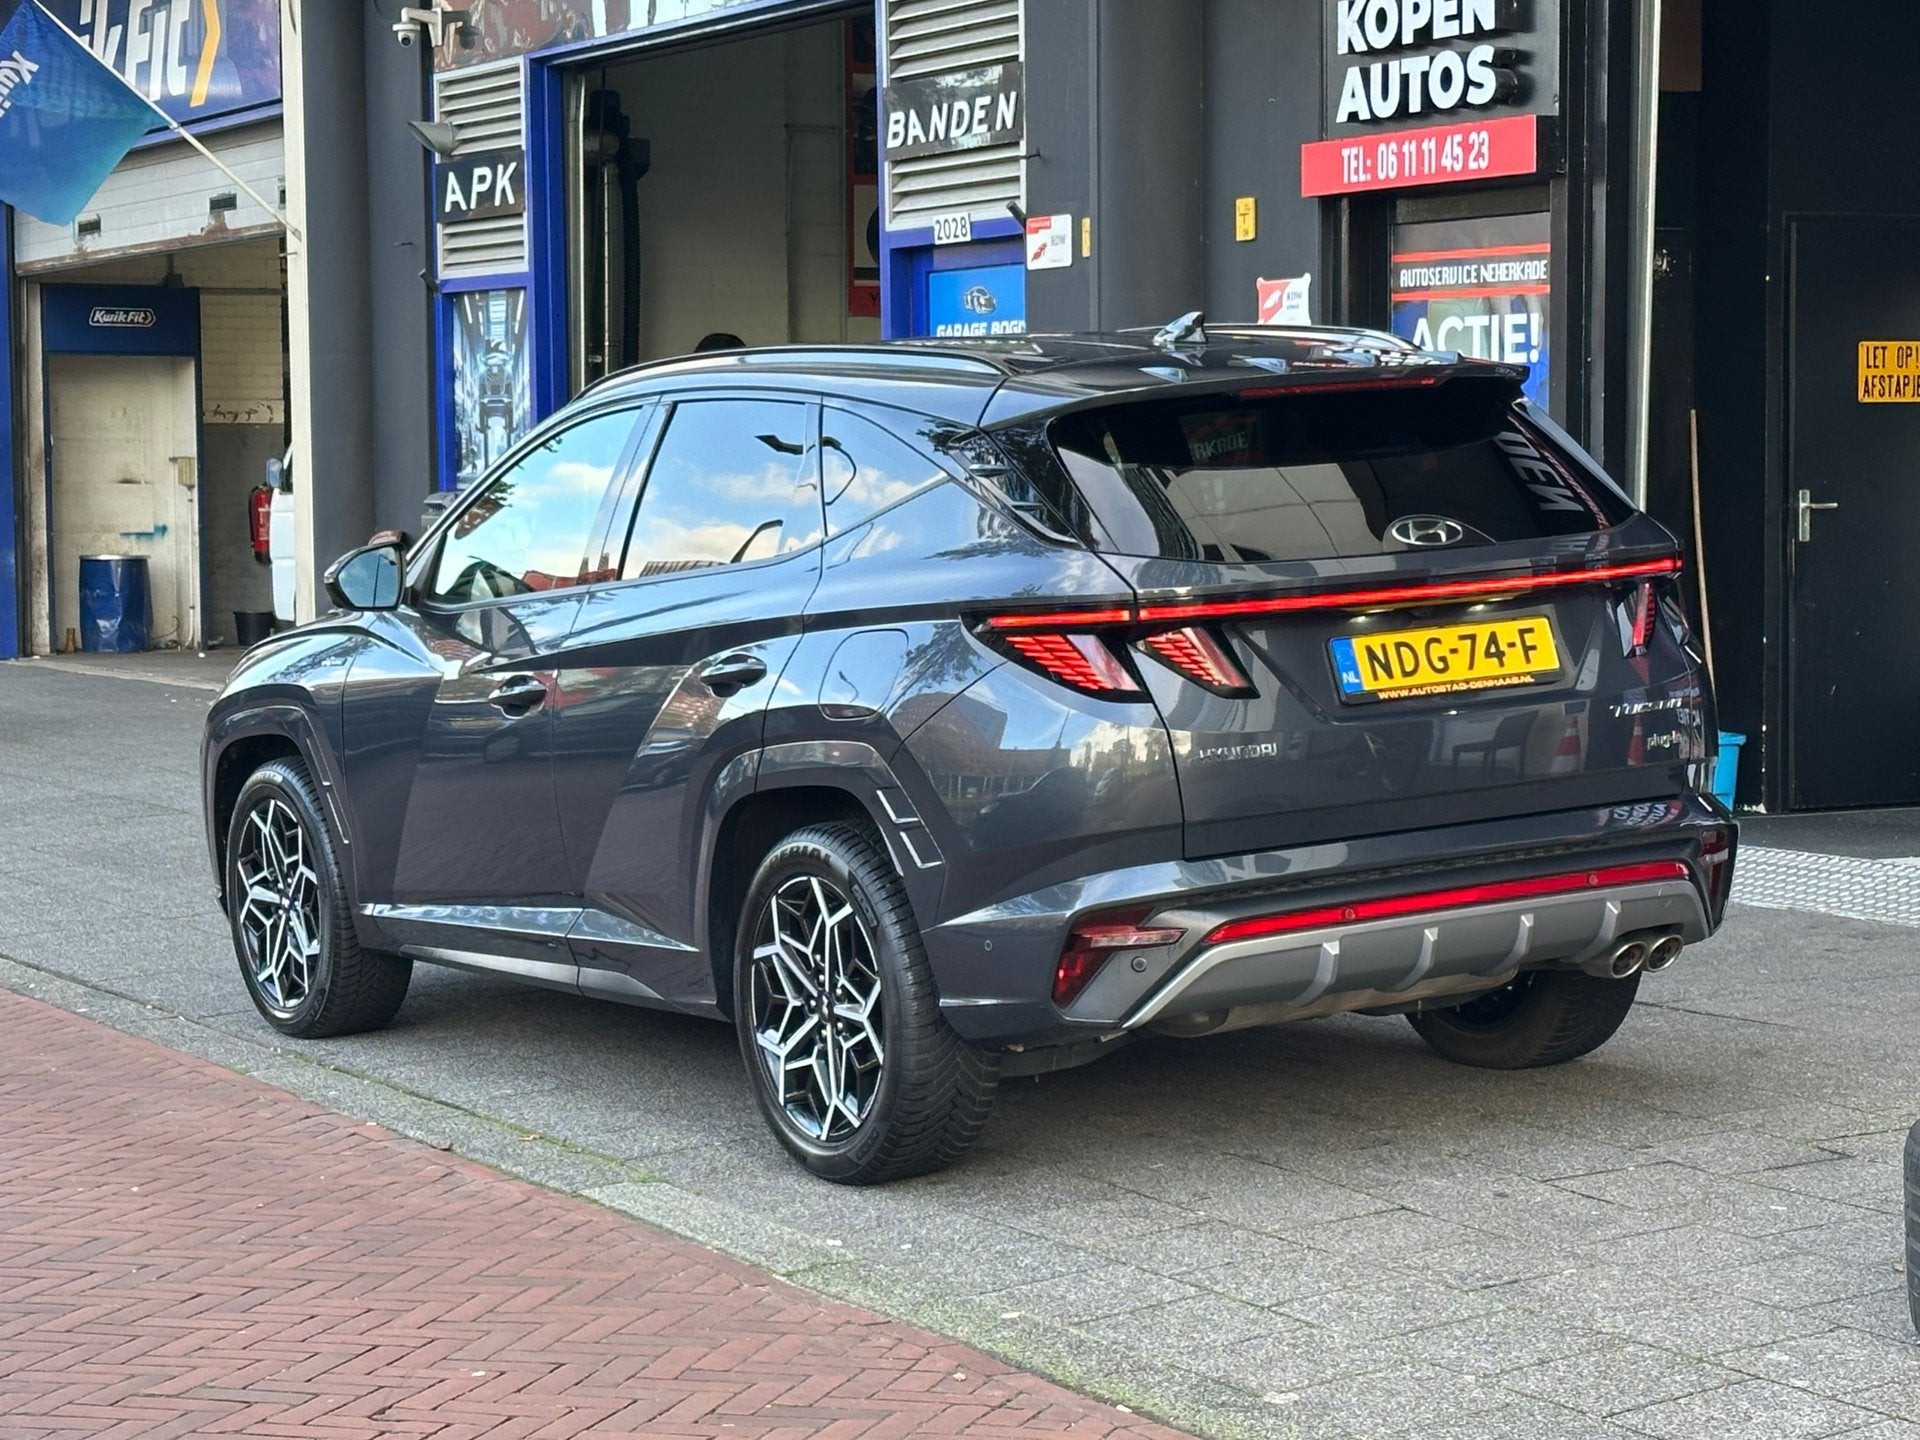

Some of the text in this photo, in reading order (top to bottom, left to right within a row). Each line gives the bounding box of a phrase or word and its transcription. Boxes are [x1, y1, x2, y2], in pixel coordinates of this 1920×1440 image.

[1337, 0, 1496, 55] KOPEN
[1336, 45, 1497, 123] AUTOS
[886, 91, 1017, 149] BANDEN
[1341, 130, 1489, 184] TEL: 06 11 11 45 23
[444, 162, 518, 213] APK
[935, 216, 968, 241] 2028
[1400, 259, 1548, 288] AUTOSERVICE NEHERKADE
[1412, 312, 1540, 364] ACTIE!
[1866, 346, 1919, 369] LET OP!
[1343, 670, 1360, 684] NL
[1364, 627, 1538, 682] NDG-74-F
